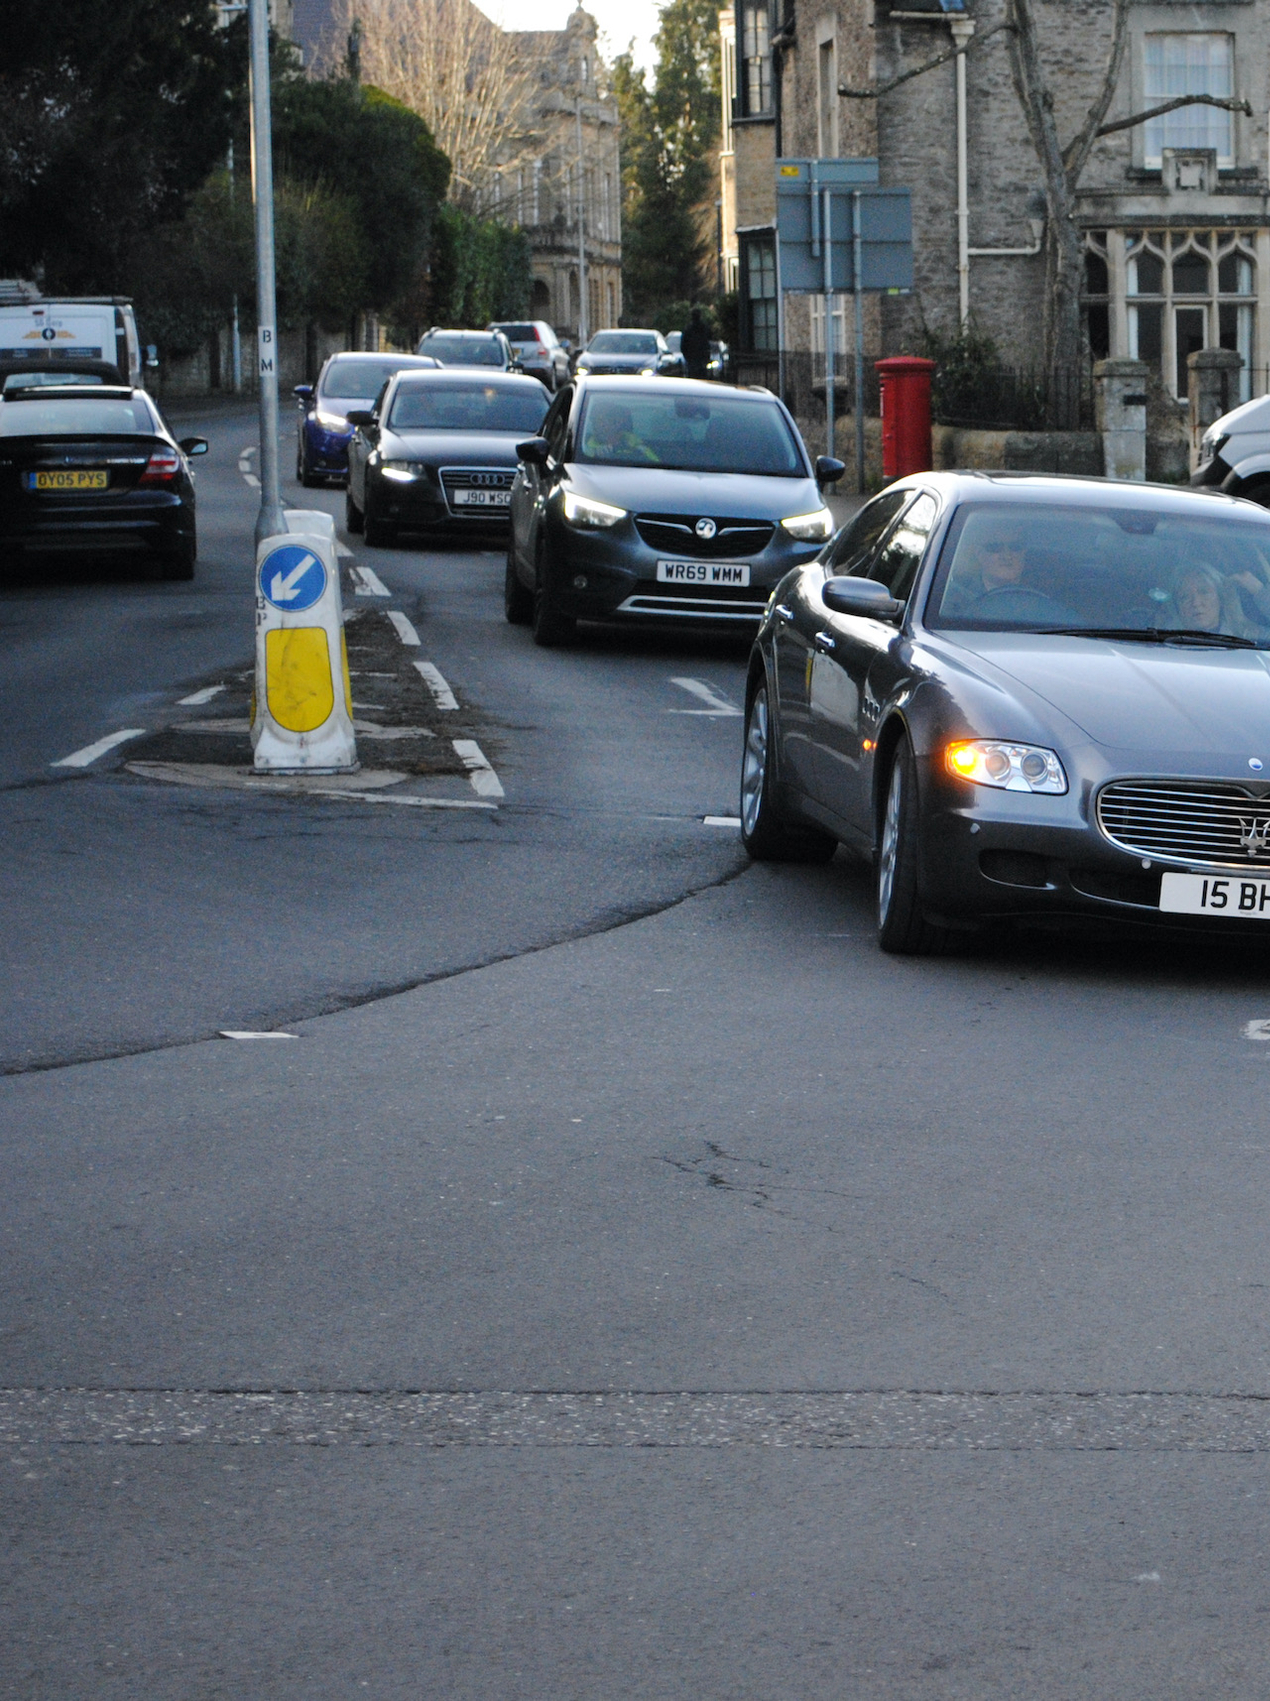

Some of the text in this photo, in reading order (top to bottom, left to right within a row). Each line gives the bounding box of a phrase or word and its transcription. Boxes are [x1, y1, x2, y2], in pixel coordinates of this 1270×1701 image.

[262, 330, 272, 343] B
[261, 359, 273, 371] M
[78, 473, 105, 487] PYS
[463, 491, 486, 503] J90
[665, 564, 743, 582] WR69 WMM
[1200, 879, 1230, 908] 15
